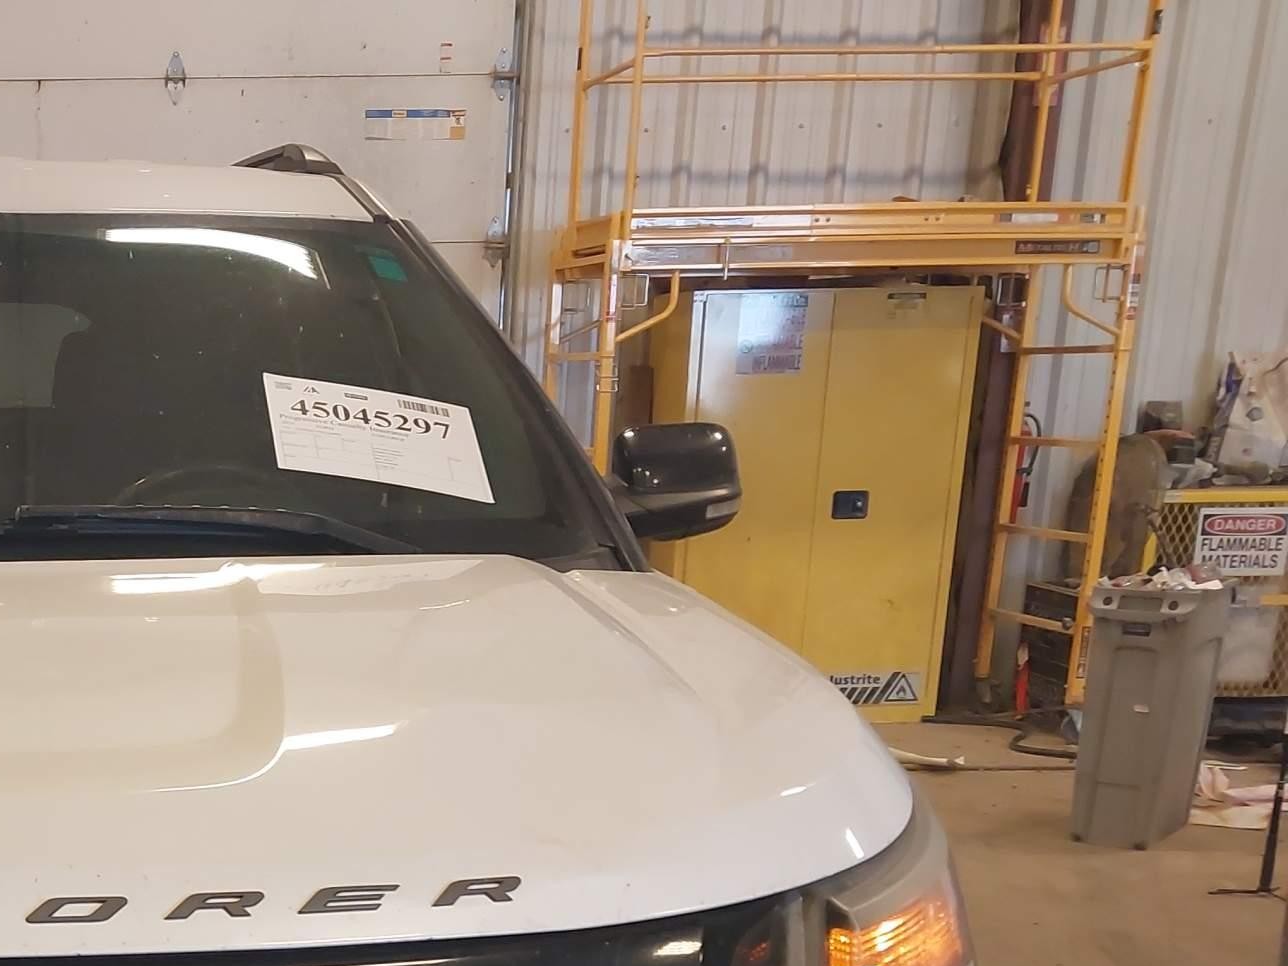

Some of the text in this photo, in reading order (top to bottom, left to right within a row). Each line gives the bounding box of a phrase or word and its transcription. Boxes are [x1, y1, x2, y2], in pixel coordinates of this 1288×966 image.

[290, 399, 450, 440] 45045297
[1214, 518, 1277, 531] DANGER
[1201, 537, 1284, 552] FLAMMABLE
[1201, 554, 1279, 569] MATERIALS
